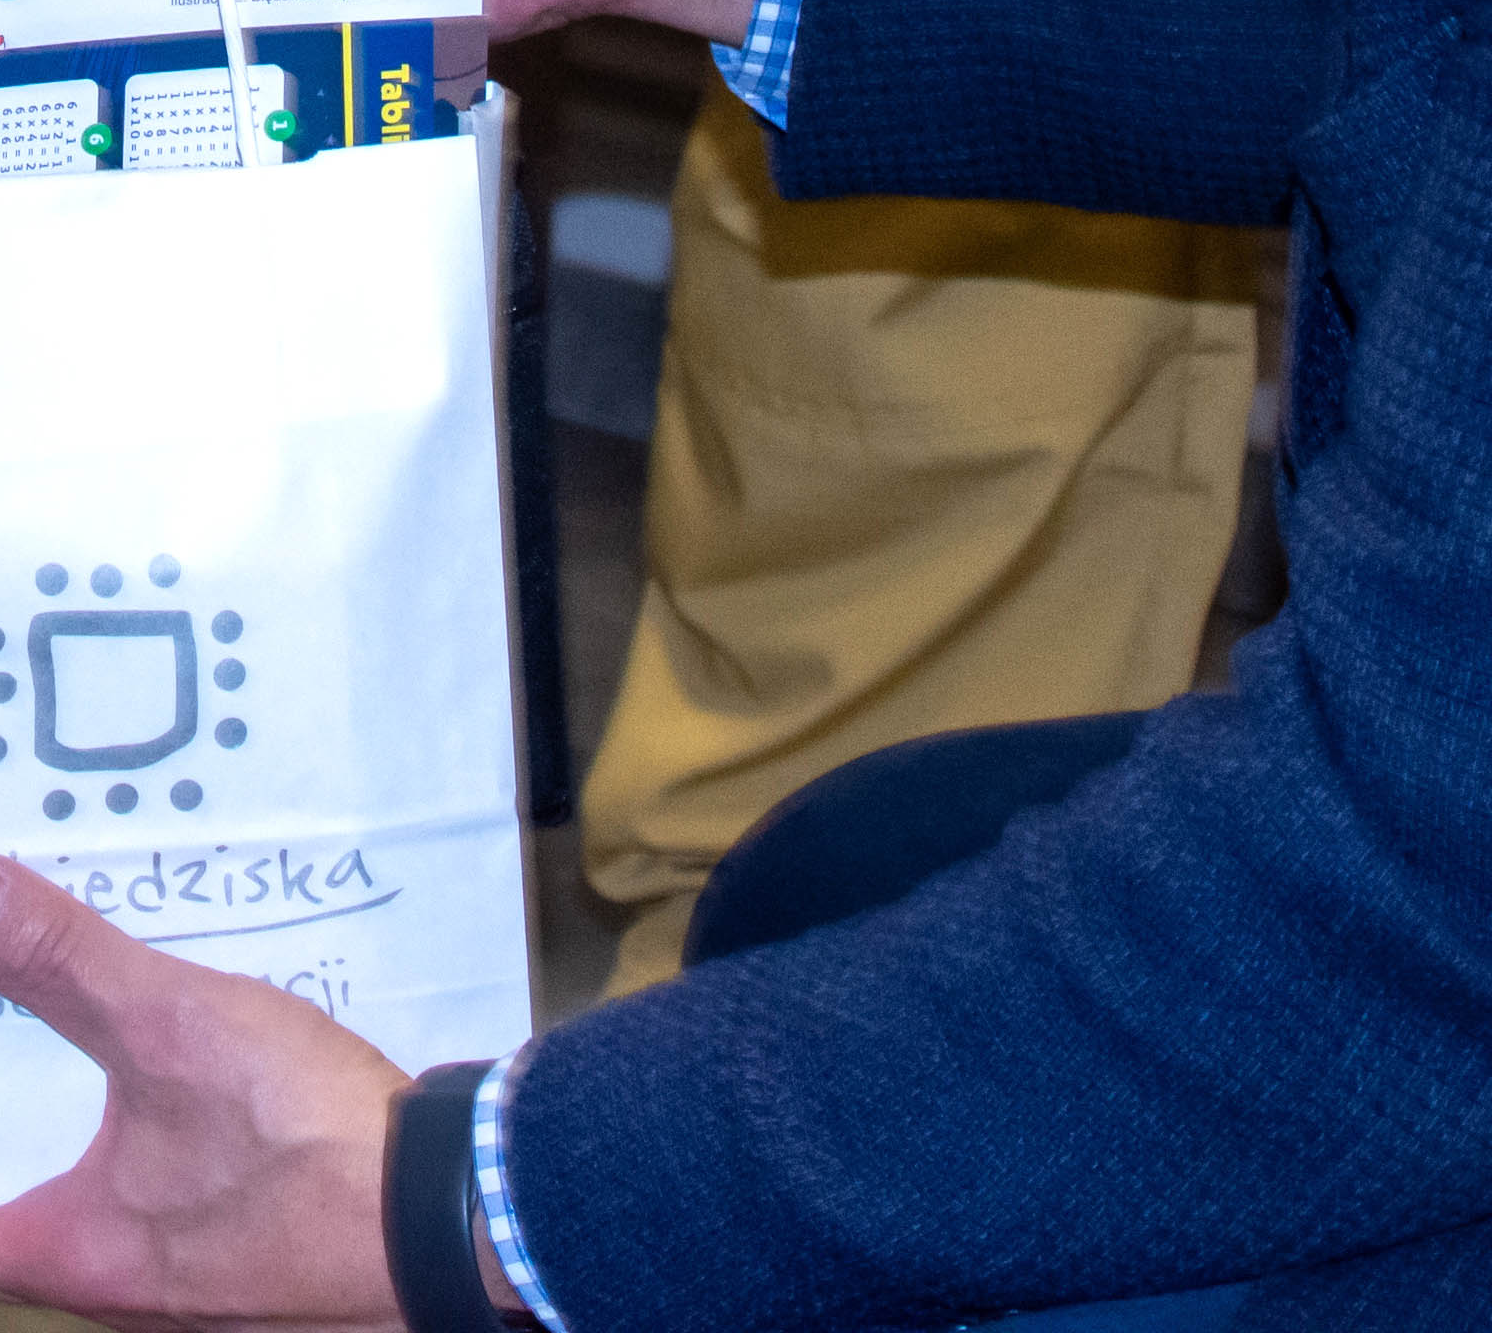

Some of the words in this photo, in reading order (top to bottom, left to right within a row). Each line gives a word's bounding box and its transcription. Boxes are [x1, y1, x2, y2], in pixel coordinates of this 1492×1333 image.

[380, 63, 410, 144] Tabli
[272, 120, 288, 131] 1
[89, 133, 105, 145] 6
